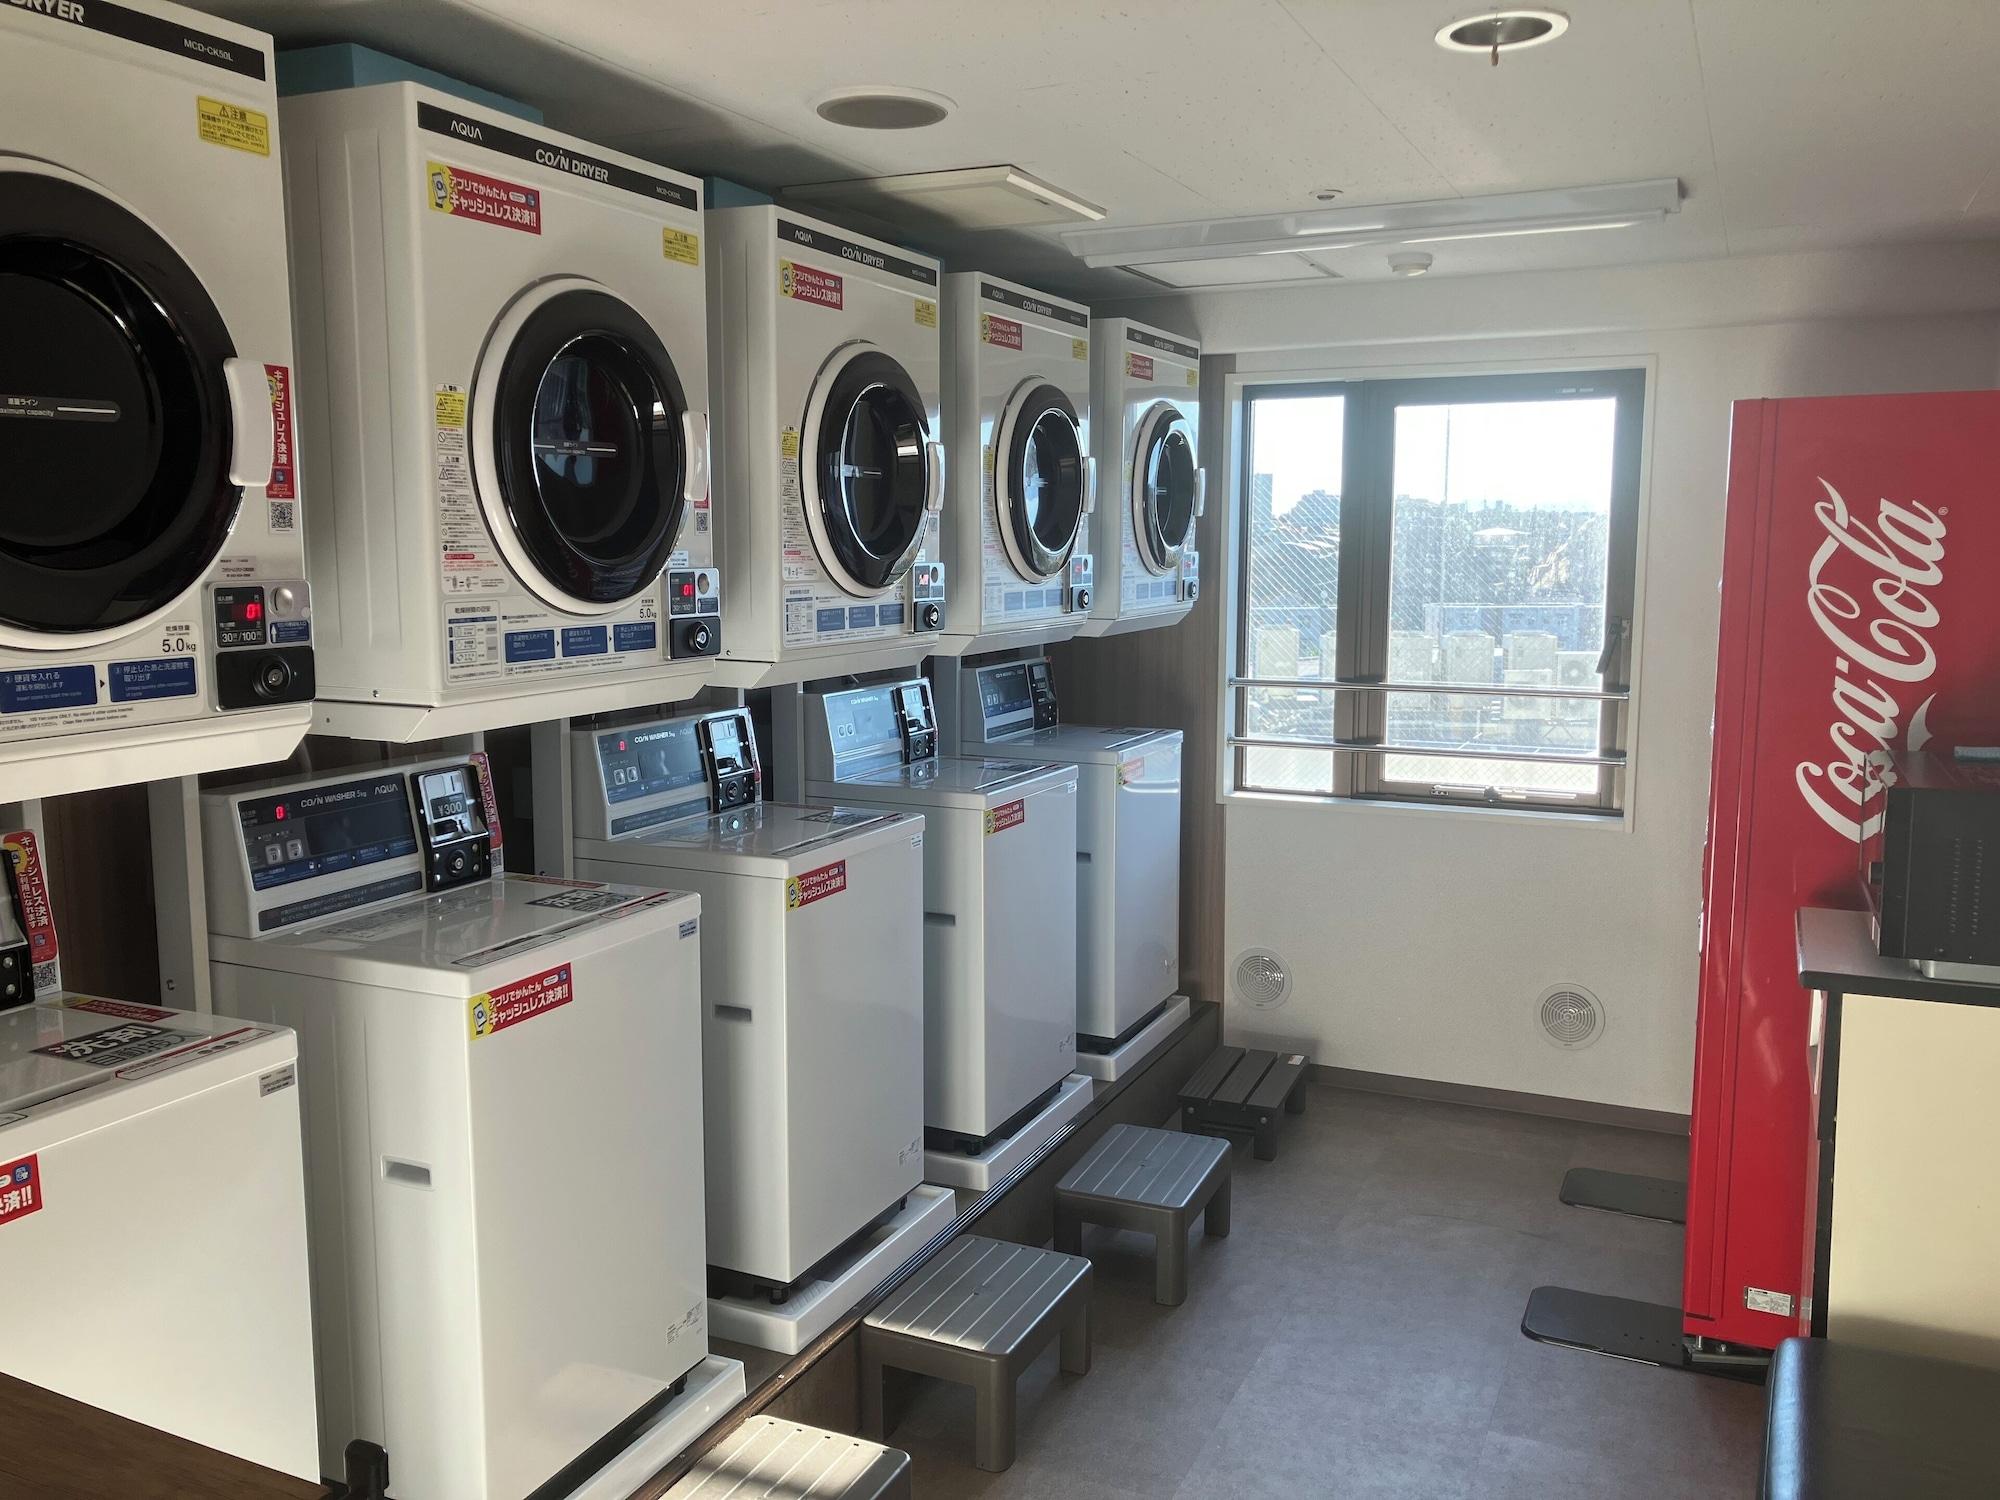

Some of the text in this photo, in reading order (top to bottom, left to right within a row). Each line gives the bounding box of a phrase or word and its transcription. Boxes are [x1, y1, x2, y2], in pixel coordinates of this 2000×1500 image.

[451, 119, 483, 141] AQUA
[571, 160, 609, 182] DRYER
[450, 176, 508, 201] アプリでかんたん
[794, 229, 813, 244] AQUA
[862, 252, 885, 268] DRYER
[27, 409, 54, 417] capacity
[1796, 476, 1947, 844] Coca-Cola
[324, 791, 355, 803] WASHER
[374, 783, 398, 796] AQUA
[437, 802, 463, 817] ¥300
[21, 836, 49, 926] キャッシュレス決済
[489, 981, 542, 1009] アプリでかんたん
[0, 1185, 33, 1215] 済!!
